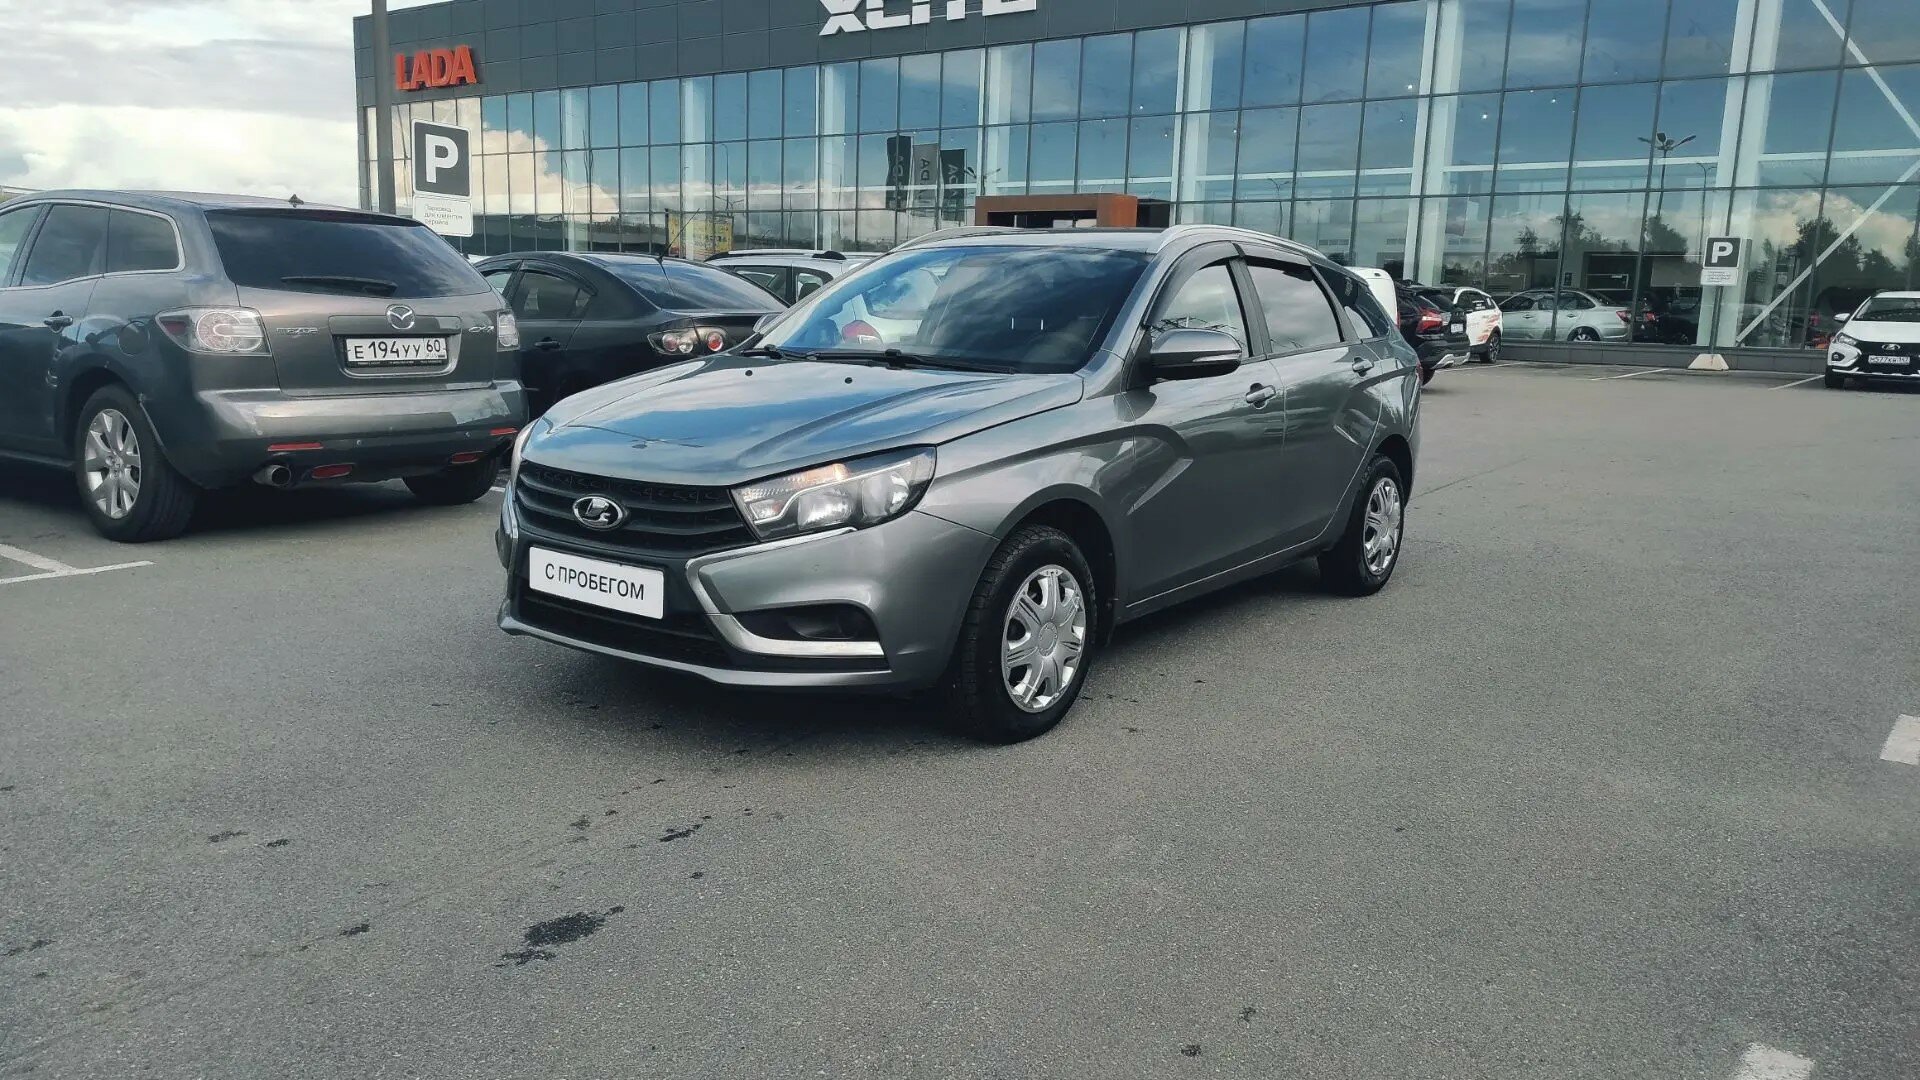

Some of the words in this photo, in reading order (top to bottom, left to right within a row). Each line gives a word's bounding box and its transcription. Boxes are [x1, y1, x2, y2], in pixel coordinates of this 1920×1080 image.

[395, 45, 477, 90] LADA
[425, 134, 459, 184] P
[1711, 241, 1733, 263] P
[545, 563, 555, 580] С
[558, 566, 645, 600] ПРОБЕГОМ
